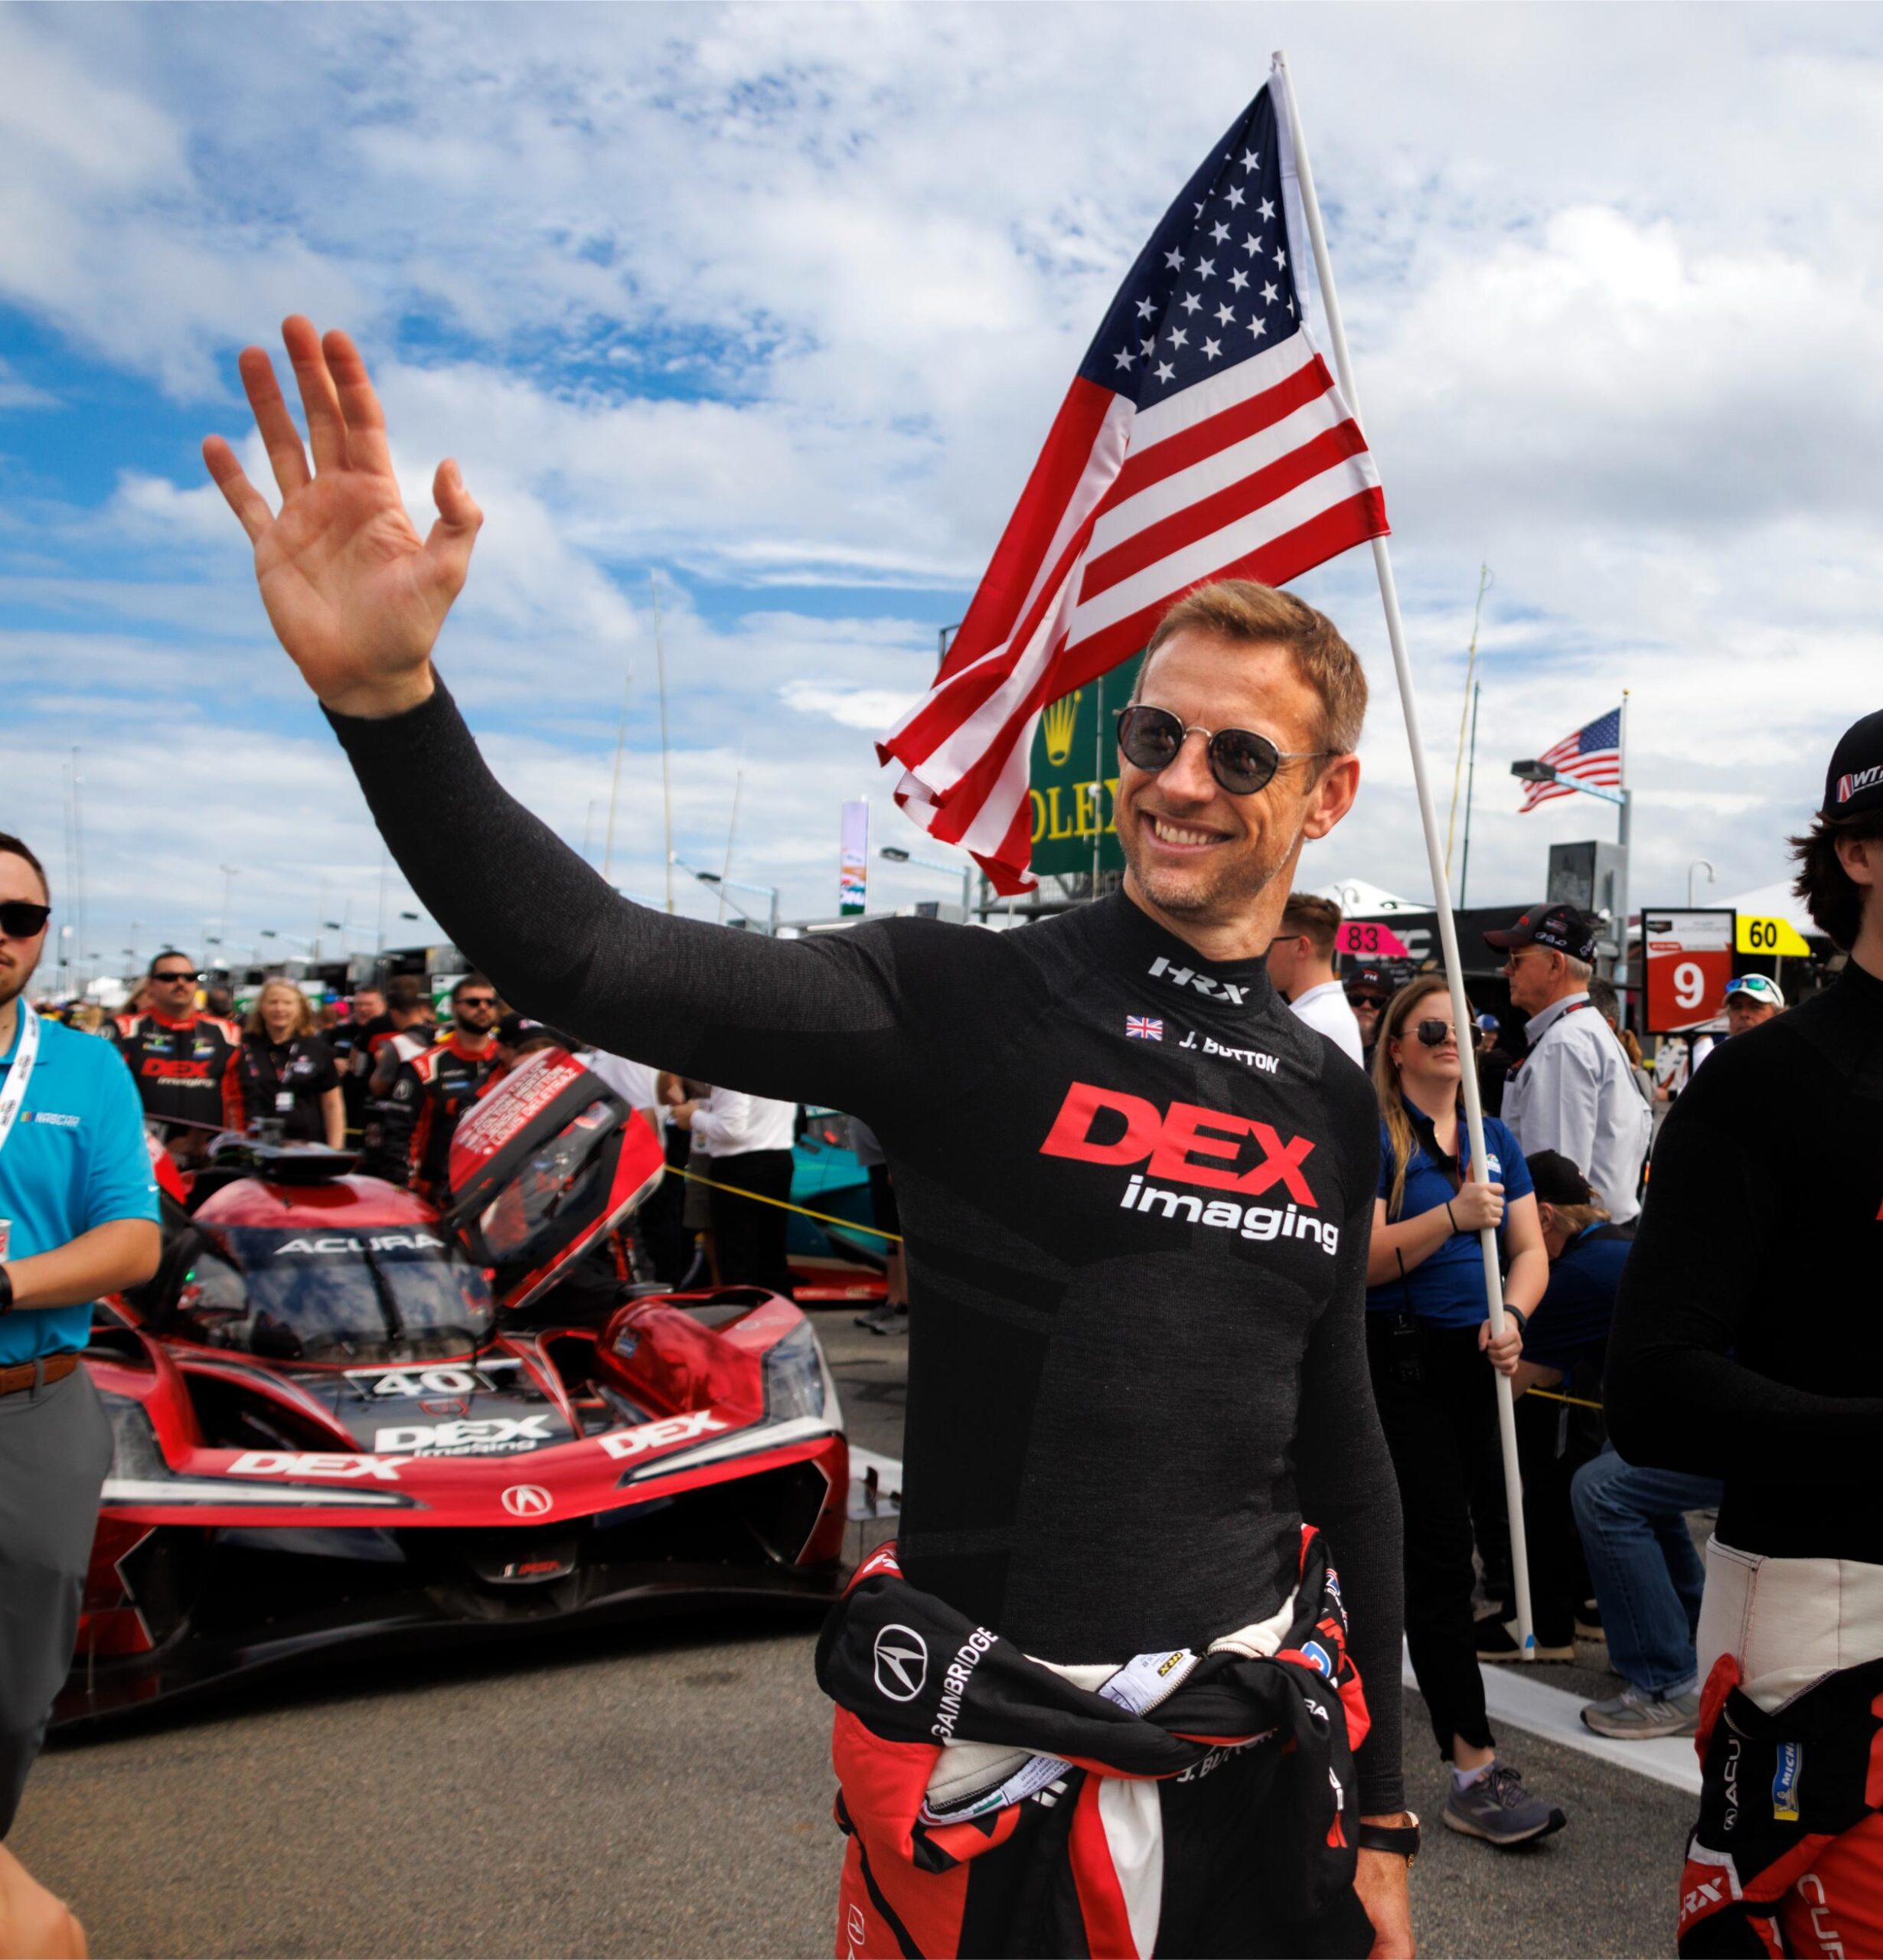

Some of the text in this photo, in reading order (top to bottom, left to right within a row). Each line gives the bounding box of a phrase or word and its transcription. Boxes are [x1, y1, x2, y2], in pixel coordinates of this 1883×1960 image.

[1347, 926, 1379, 952] 83
[1750, 920, 1777, 948] 60
[1148, 957, 1251, 1004] HRX
[1673, 962, 1705, 1009] 9
[141, 1057, 212, 1078] DEX
[1179, 1031, 1279, 1073] J. BUTTON
[35, 1112, 80, 1127] NASCAR
[1039, 1081, 1319, 1209] DEX
[1120, 1174, 1339, 1256] imaging
[273, 1235, 446, 1255] ACURA
[373, 1370, 476, 1396] 40
[375, 1413, 553, 1453] DEX
[598, 1409, 729, 1459] DEX
[227, 1453, 415, 1480] DEX
[931, 1626, 999, 1739] GAINBRIDGE
[1160, 1651, 1183, 1677] HRX
[1724, 1736, 1741, 1808] ACU
